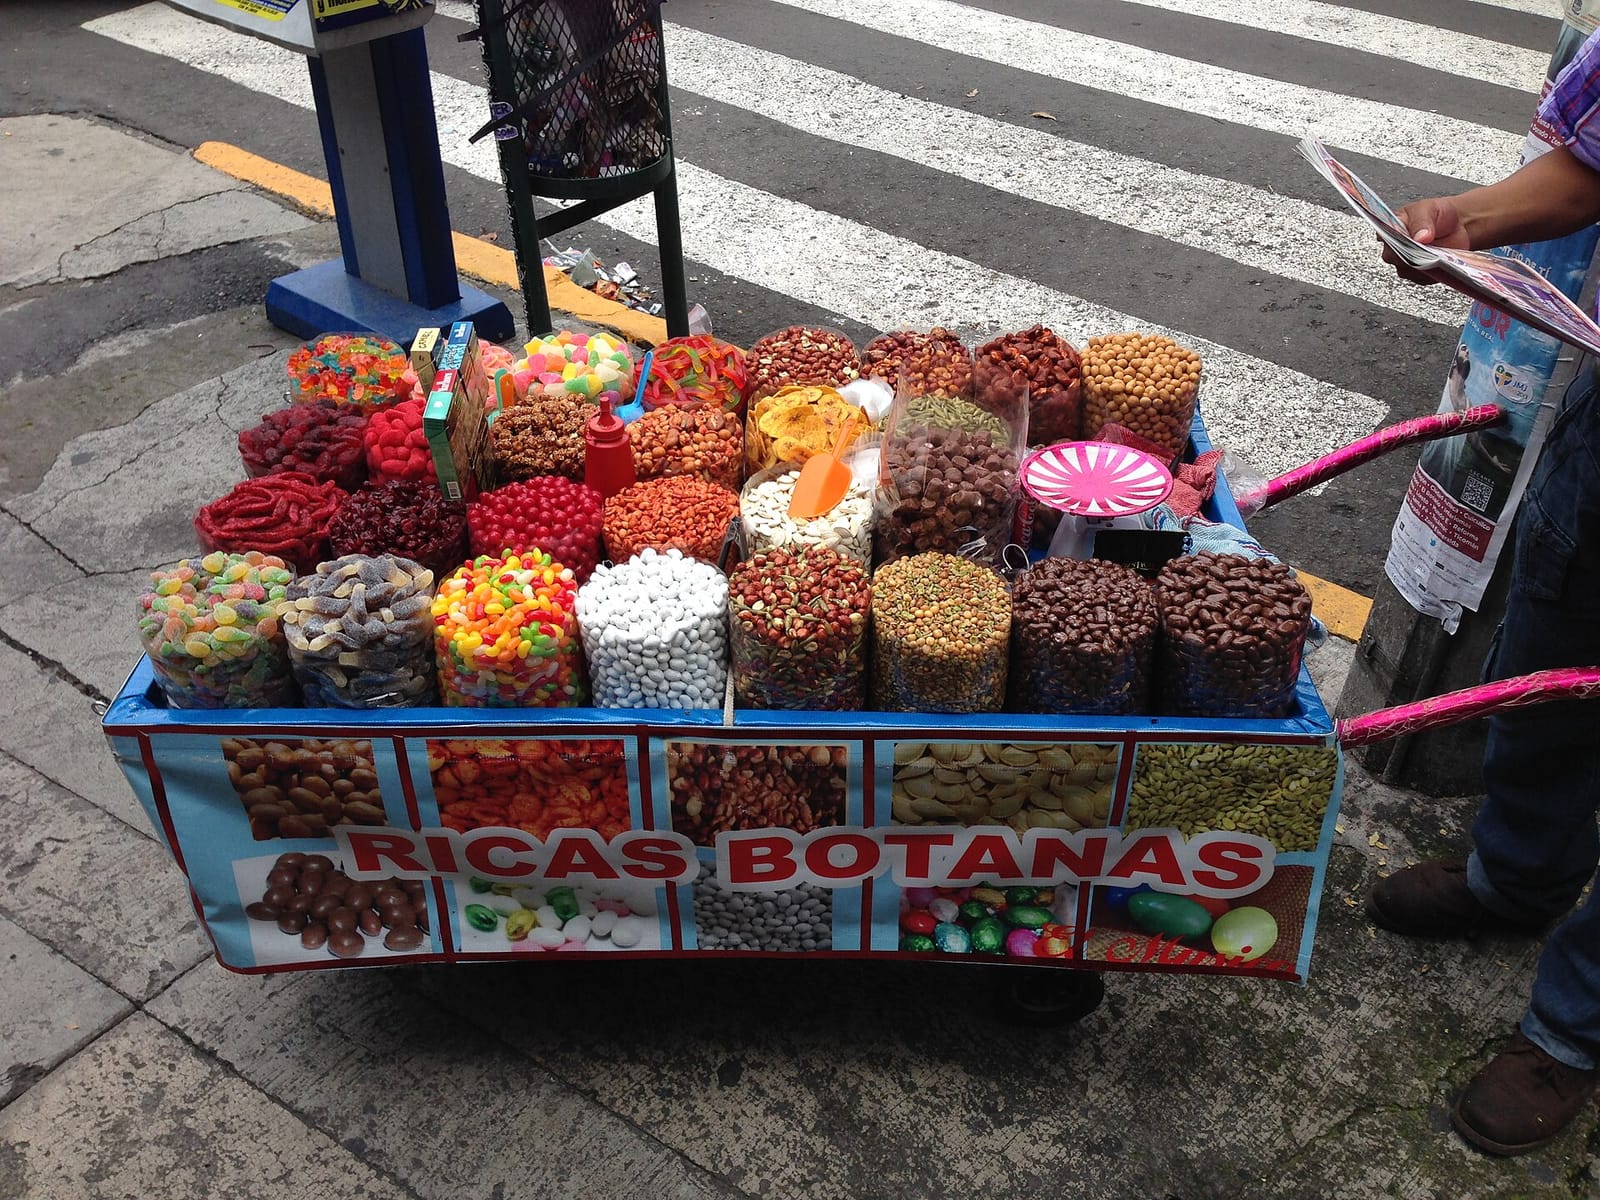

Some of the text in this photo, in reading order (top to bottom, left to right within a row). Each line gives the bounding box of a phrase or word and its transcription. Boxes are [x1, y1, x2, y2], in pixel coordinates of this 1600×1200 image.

[1453, 523, 1479, 542] Reforma
[1453, 532, 1480, 551] Ticomán
[350, 831, 1262, 889] RICAS BOTANAS
